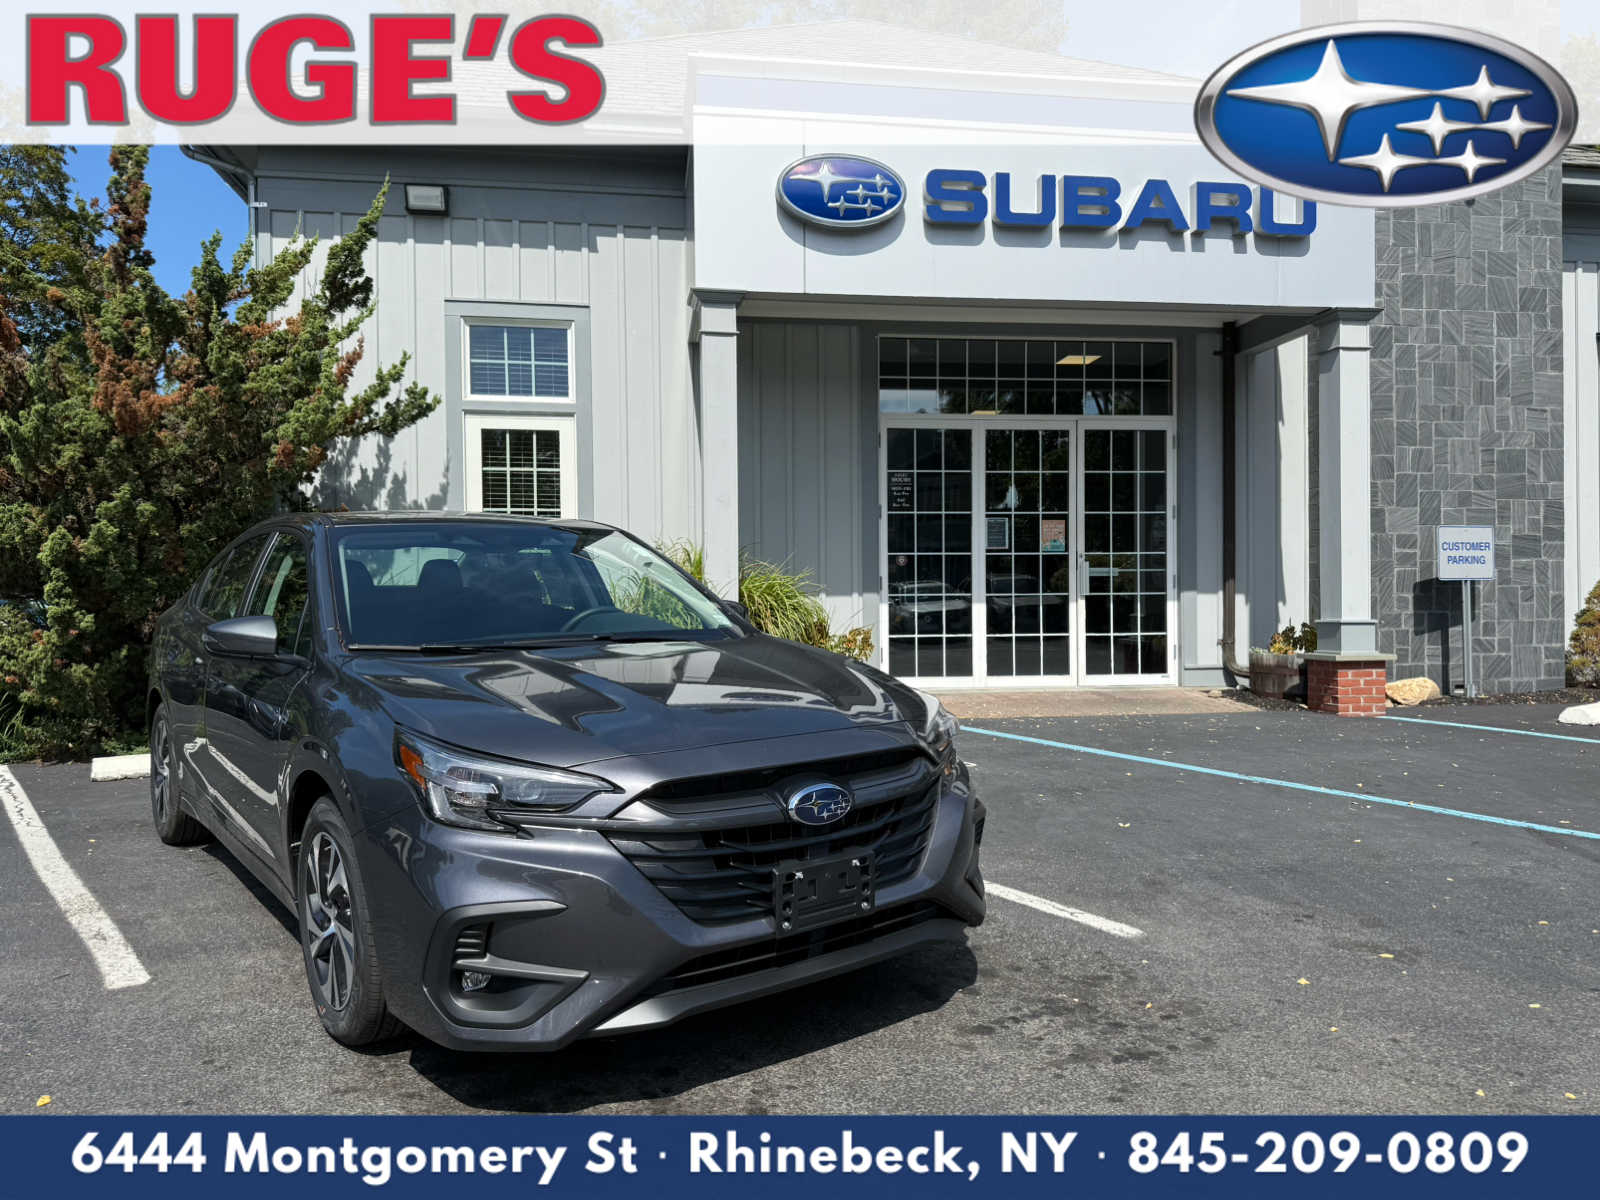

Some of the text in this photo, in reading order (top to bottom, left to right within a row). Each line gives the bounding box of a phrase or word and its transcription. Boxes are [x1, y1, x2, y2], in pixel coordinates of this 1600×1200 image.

[924, 168, 1318, 238] SUBARU
[1441, 541, 1491, 551] CUSTOMER
[1447, 555, 1486, 565] PARKING
